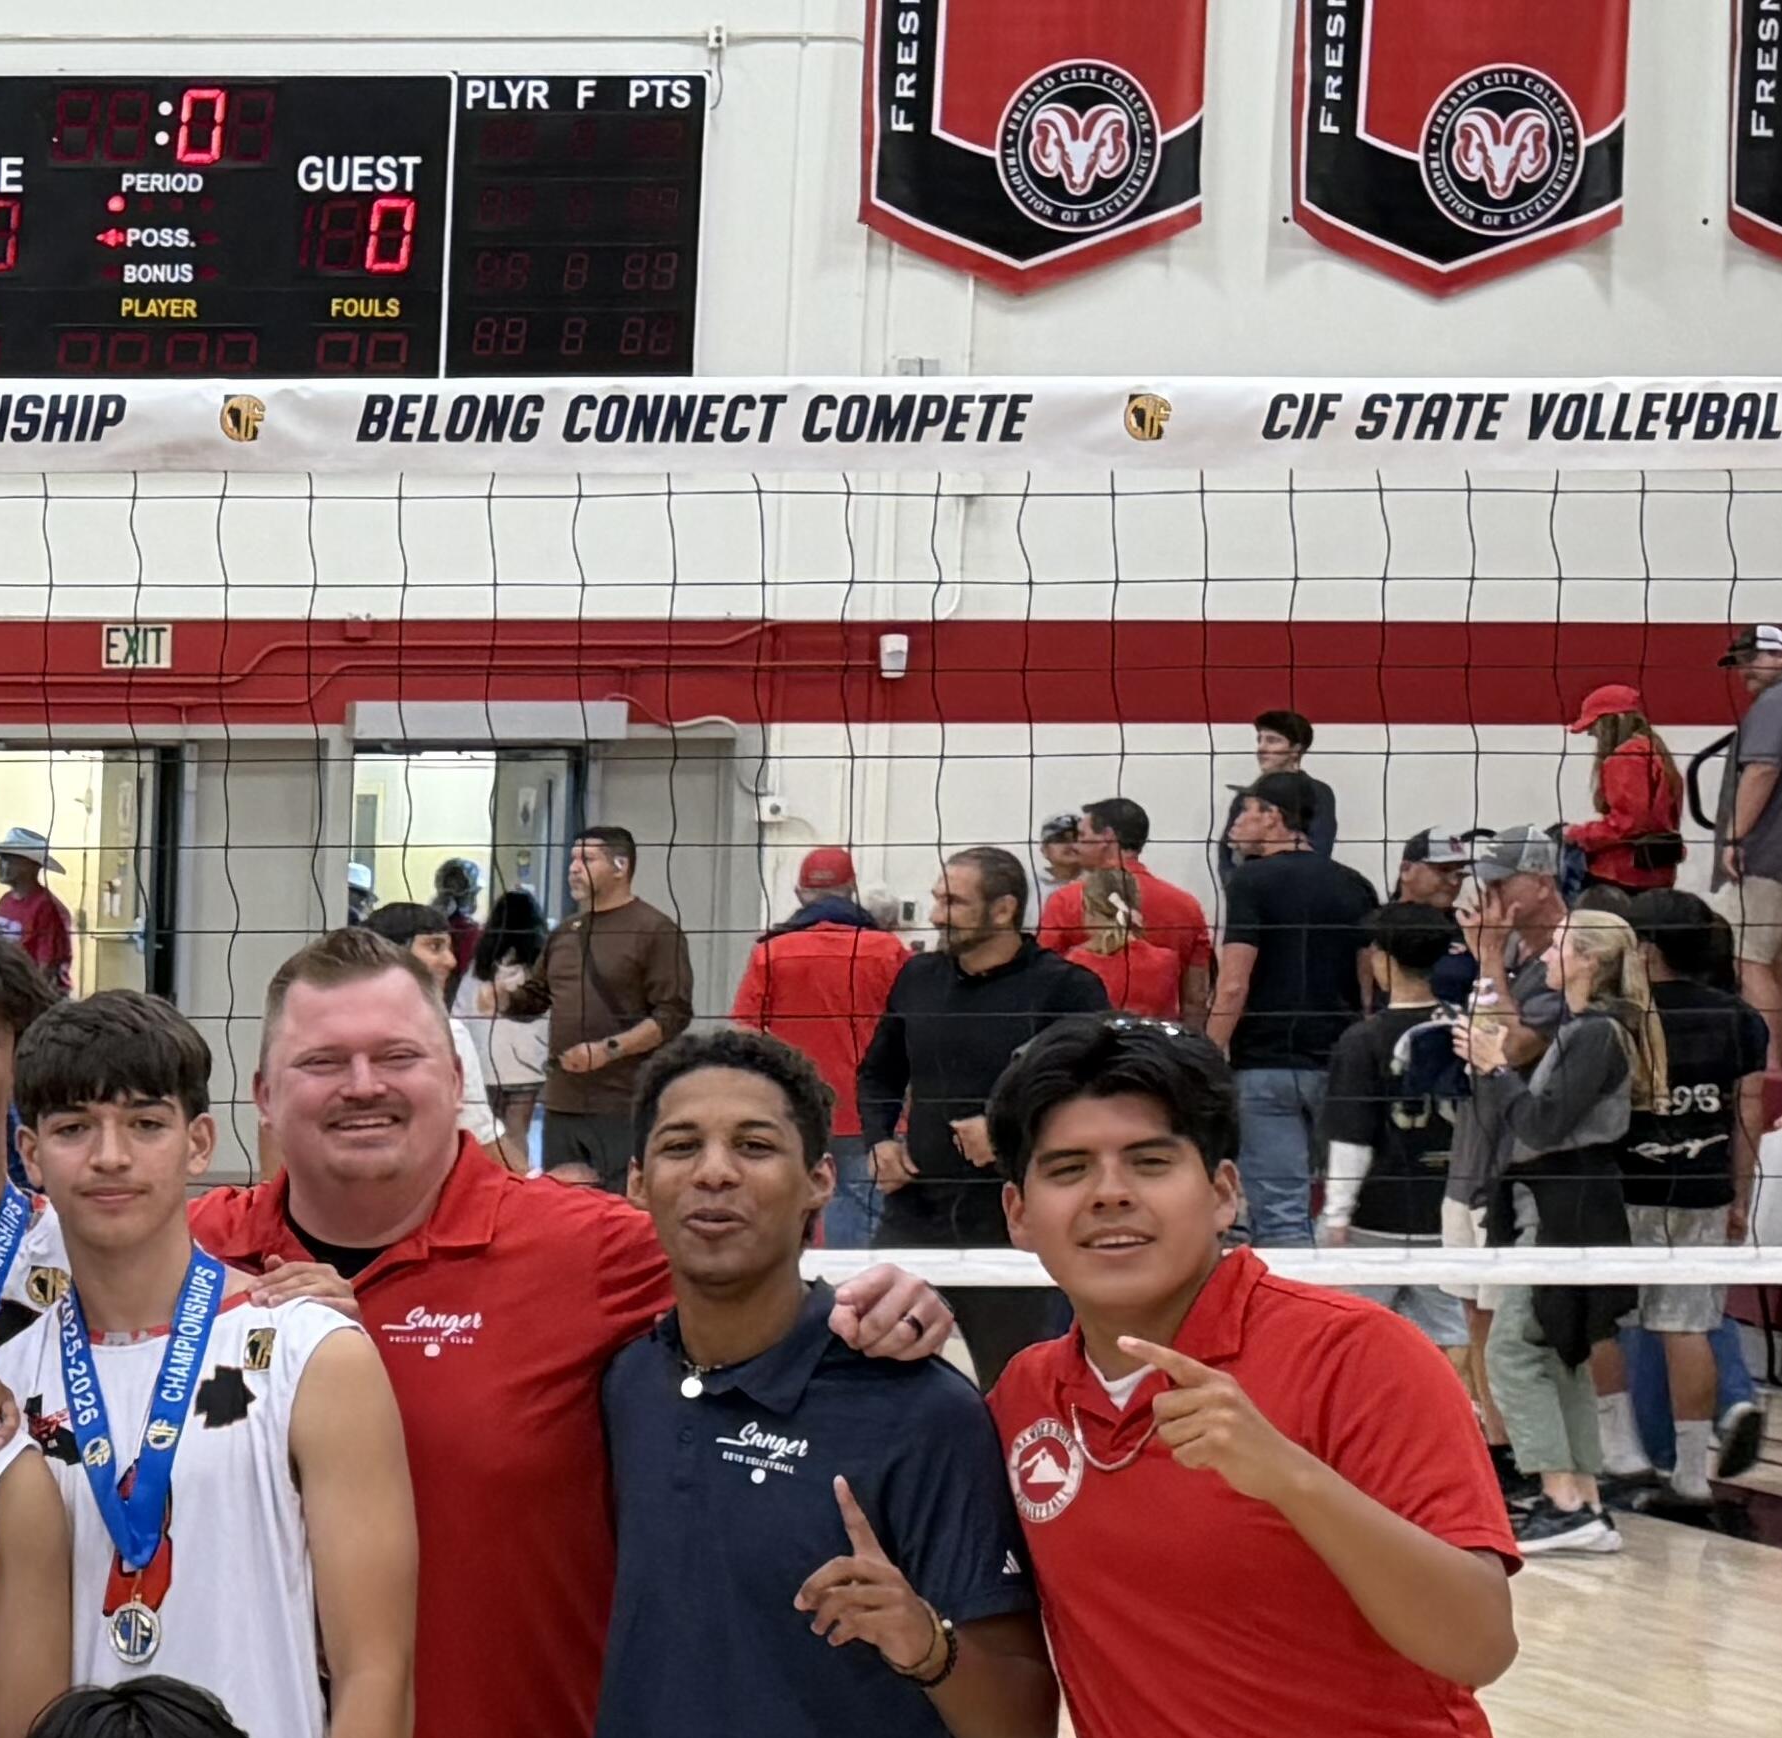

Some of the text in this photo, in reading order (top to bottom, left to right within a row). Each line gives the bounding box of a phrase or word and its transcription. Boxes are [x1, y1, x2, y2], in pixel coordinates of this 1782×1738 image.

[891, 0, 920, 133] FRES
[1319, 0, 1347, 134] FRES
[465, 80, 691, 109] PLYR F PTS
[121, 173, 203, 193] PERIOD
[297, 155, 422, 193] GUEST
[126, 228, 196, 249] POSS.
[123, 264, 194, 284] BONUS
[121, 298, 197, 319] PLAYER
[331, 298, 401, 319] FOULS
[357, 395, 1032, 442] BELONG CONNECT COMPETE
[1262, 394, 1342, 440] CIF
[1356, 394, 1508, 441] STATE
[106, 627, 164, 663] EXIT
[161, 1265, 217, 1402] CHAMPIONSHIPS
[381, 1305, 482, 1336] Sanger
[61, 1296, 99, 1426] 2025-2026
[715, 1421, 808, 1460] Sanger
